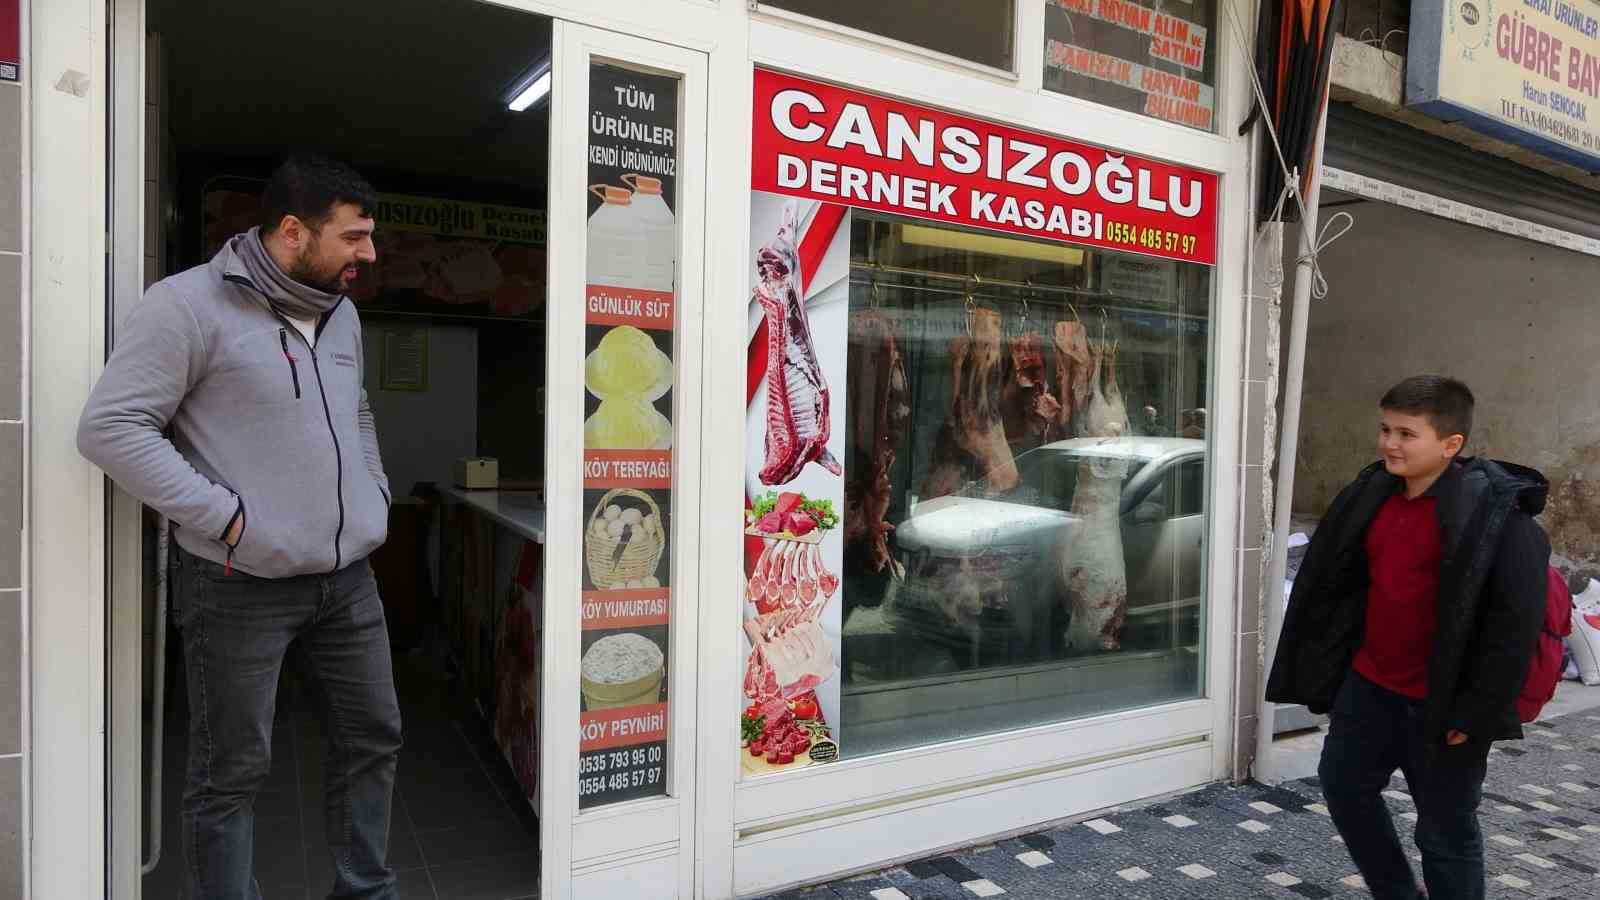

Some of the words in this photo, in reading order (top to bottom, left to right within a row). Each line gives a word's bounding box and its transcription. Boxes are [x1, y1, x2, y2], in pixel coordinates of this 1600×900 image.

[1155, 12, 1189, 43] ALIM
[1496, 10, 1563, 82] GÜBRE
[1567, 46, 1600, 99] BAY
[614, 85, 655, 111] TÜM
[1141, 67, 1201, 102] HAYVAN
[1522, 79, 1548, 106] Harun
[592, 111, 674, 147] ÜRÜNLER
[589, 144, 618, 167] KENDİ
[621, 146, 676, 176] ÜRÜNÜMÜZ
[770, 89, 1204, 217] CANSIZOĞLU
[777, 154, 957, 216] DERNEK
[971, 191, 1104, 241] KASABI
[1106, 221, 1138, 244] 0554
[1140, 226, 1163, 249] 485
[1165, 231, 1181, 252] 57
[1182, 234, 1197, 256] 97
[589, 294, 642, 316] GÜNLÜK
[646, 298, 670, 319] SÜT
[584, 456, 609, 478] KÖY
[612, 458, 669, 479] TEREYAĞI
[605, 599, 667, 618] YUMURTASI
[579, 719, 607, 740] KÖY
[611, 710, 664, 737] PEYNİRİ
[579, 754, 606, 774] 0535
[609, 751, 629, 769] 793
[632, 749, 646, 766] 95
[648, 746, 661, 763] 00
[579, 776, 606, 796] 0554
[608, 772, 629, 791] 485
[632, 770, 645, 787] 57
[648, 767, 661, 784] 97
